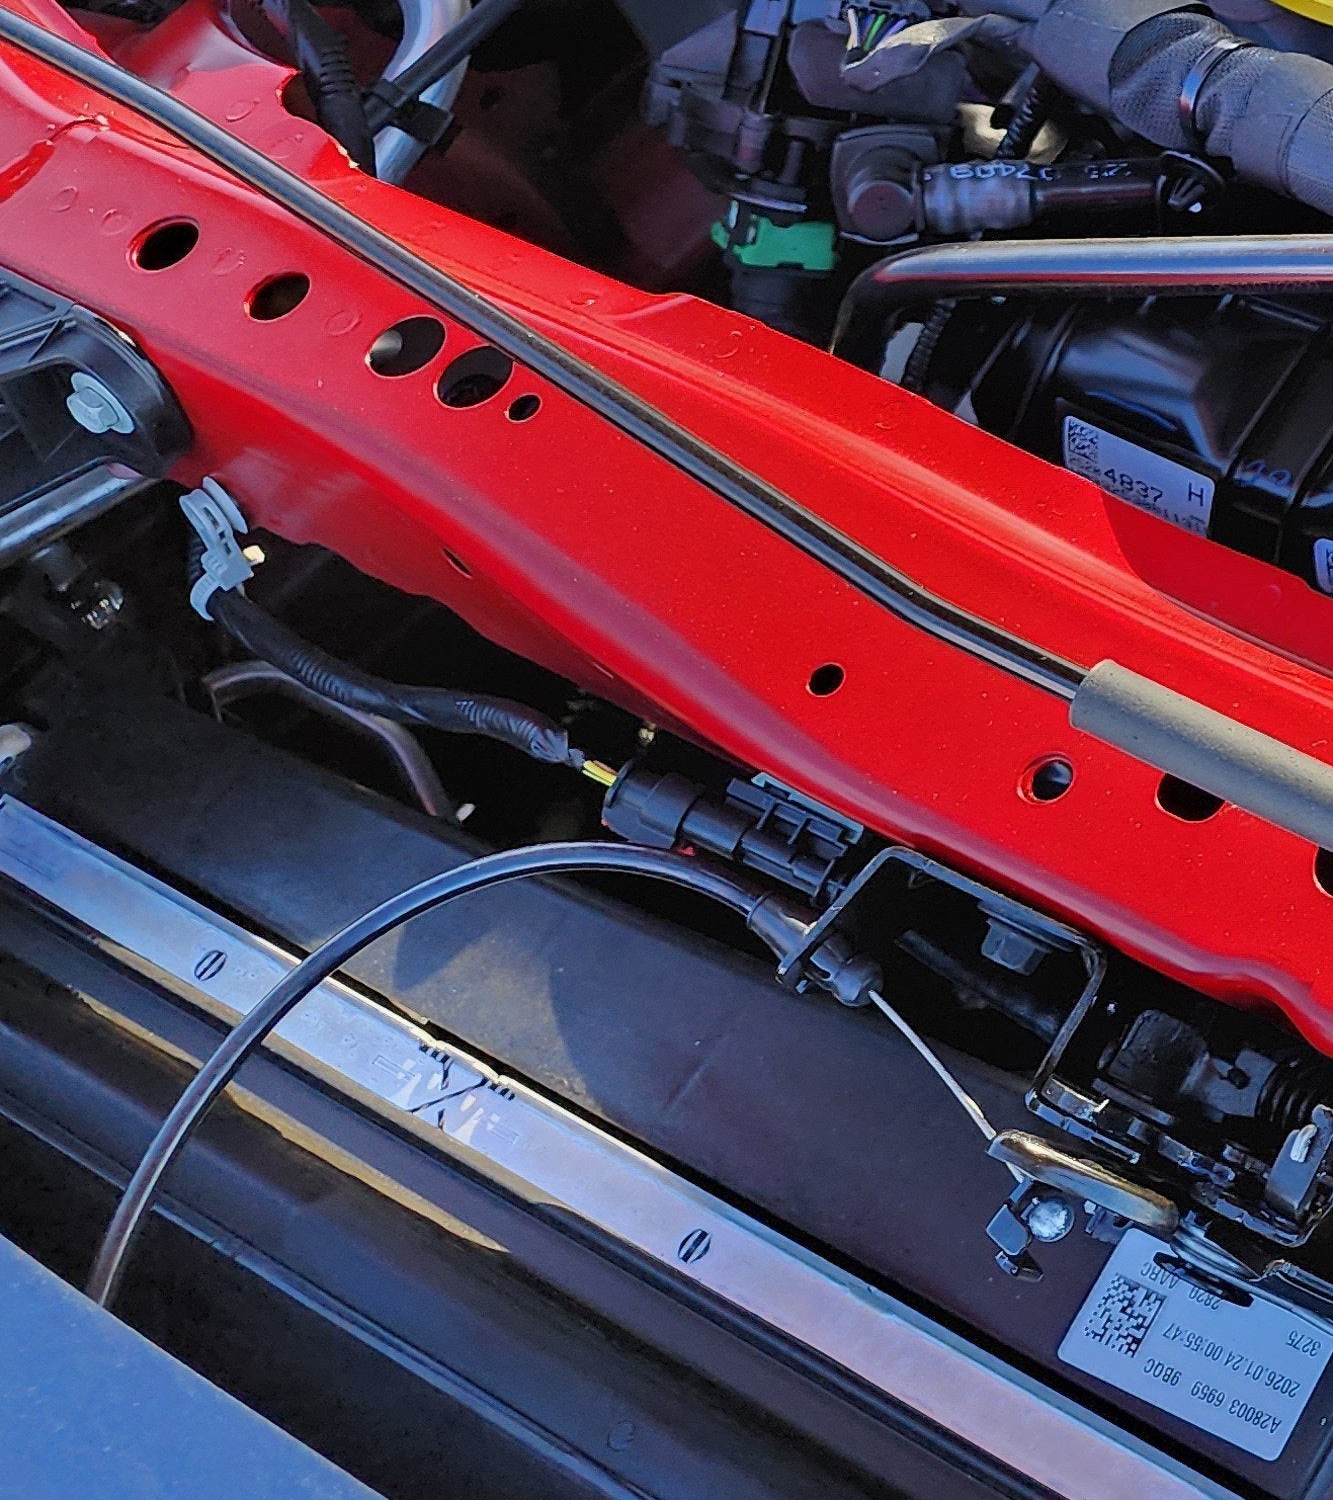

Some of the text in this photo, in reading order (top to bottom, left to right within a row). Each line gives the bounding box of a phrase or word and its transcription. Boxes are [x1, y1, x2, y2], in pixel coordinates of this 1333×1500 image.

[1188, 481, 1205, 508] H
[1285, 1329, 1322, 1357] 3275
[1162, 1322, 1301, 1399] 2026.01.24 00:55:47
[1190, 1381, 1226, 1408] 6959
[1229, 1398, 1283, 1434] A28003
